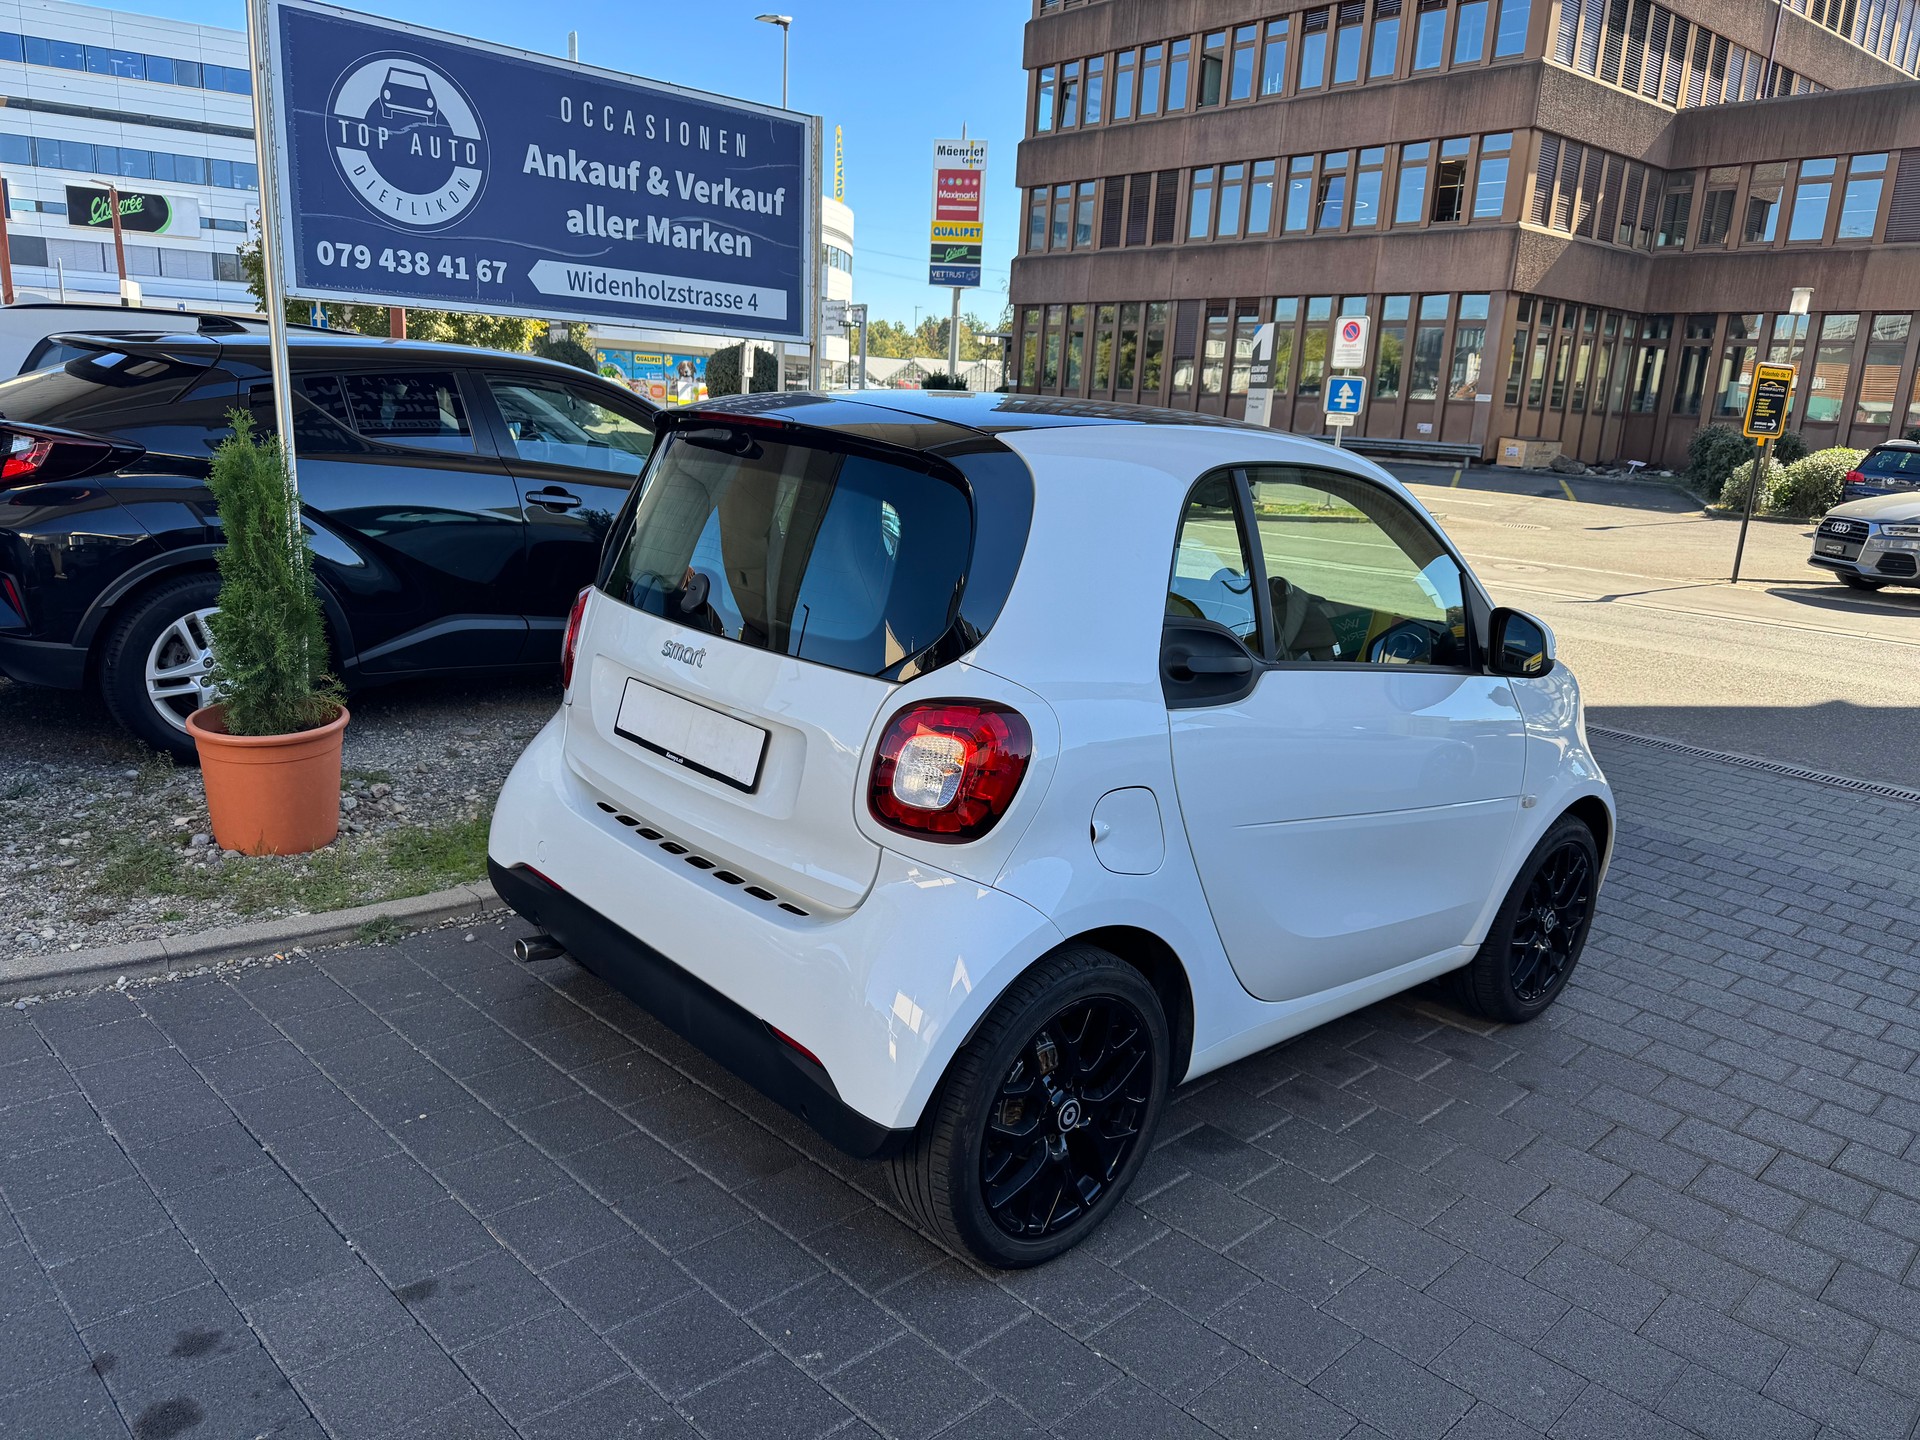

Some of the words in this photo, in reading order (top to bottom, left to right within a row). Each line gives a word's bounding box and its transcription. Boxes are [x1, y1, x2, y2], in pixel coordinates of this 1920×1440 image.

[338, 119, 389, 149] TOP
[410, 132, 476, 165] AUTO
[560, 96, 746, 158] OCCASIONEN
[937, 145, 984, 157] Mäenriet
[353, 164, 470, 216] DIETLIKON
[522, 143, 641, 192] Ankauf
[646, 165, 669, 197] &
[675, 170, 786, 216] Verkauf
[939, 190, 978, 200] Maximarkt
[90, 194, 144, 222] Chiorée
[566, 203, 639, 241] aller
[647, 215, 752, 258] Marken
[933, 226, 981, 237] QUALIPET
[317, 240, 371, 270] 079
[379, 248, 430, 276] 438
[437, 254, 470, 281] 41
[476, 259, 508, 284] 67
[566, 269, 743, 310] Widenholzstrasse
[747, 293, 759, 312] 4
[661, 640, 707, 668] smart
